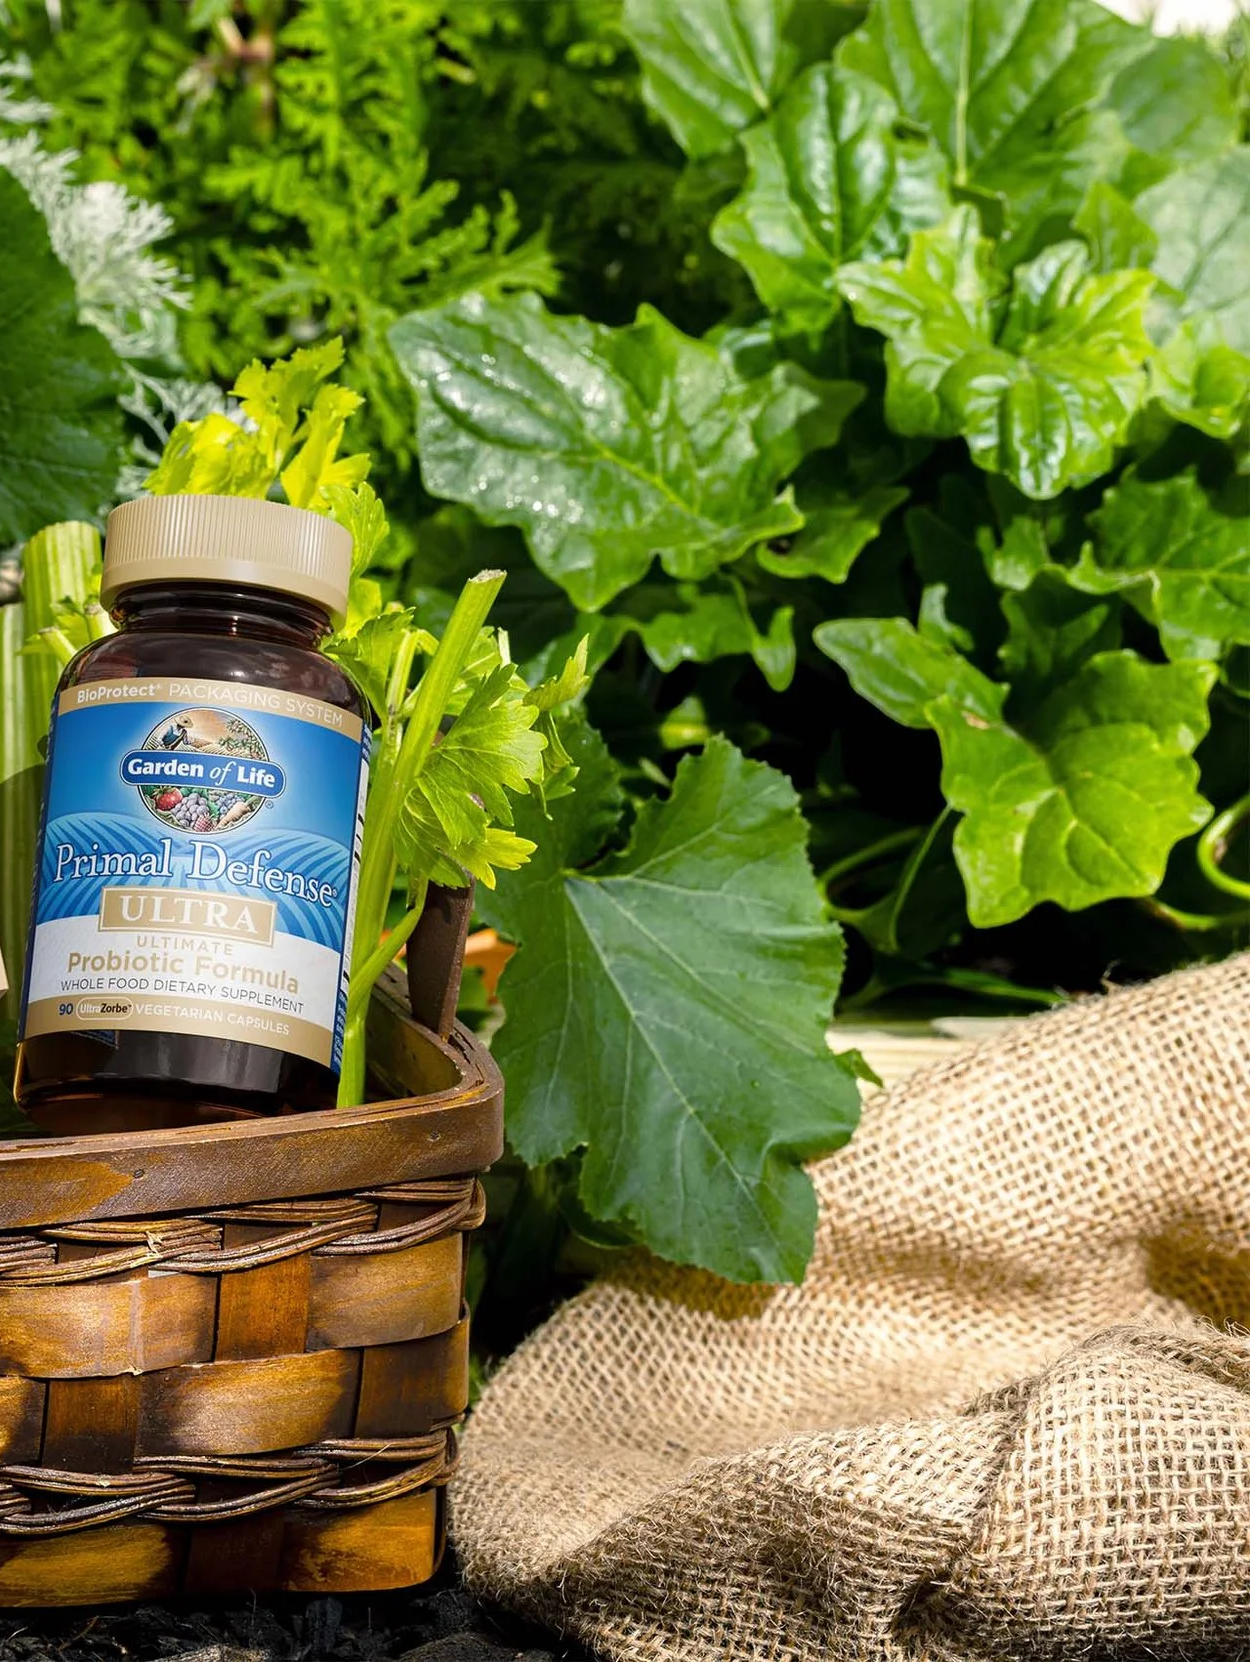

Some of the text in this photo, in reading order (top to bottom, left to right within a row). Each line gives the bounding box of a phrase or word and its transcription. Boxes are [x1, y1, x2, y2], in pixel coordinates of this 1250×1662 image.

[168, 684, 281, 710] PACKAGING
[286, 700, 343, 727] SYSTEM
[127, 758, 276, 788] Garden of Life
[53, 838, 173, 883] Primal
[119, 893, 259, 937] ULTRA
[136, 935, 234, 957] ULTIMATE
[67, 950, 299, 995] Probiotic Formula
[60, 976, 305, 1015] WHOLE FOOD DIETARY SUPPLEMENT
[58, 1003, 74, 1016] 90
[136, 1003, 224, 1023] VEGETARIAN
[227, 1014, 290, 1037] CAPSULES
